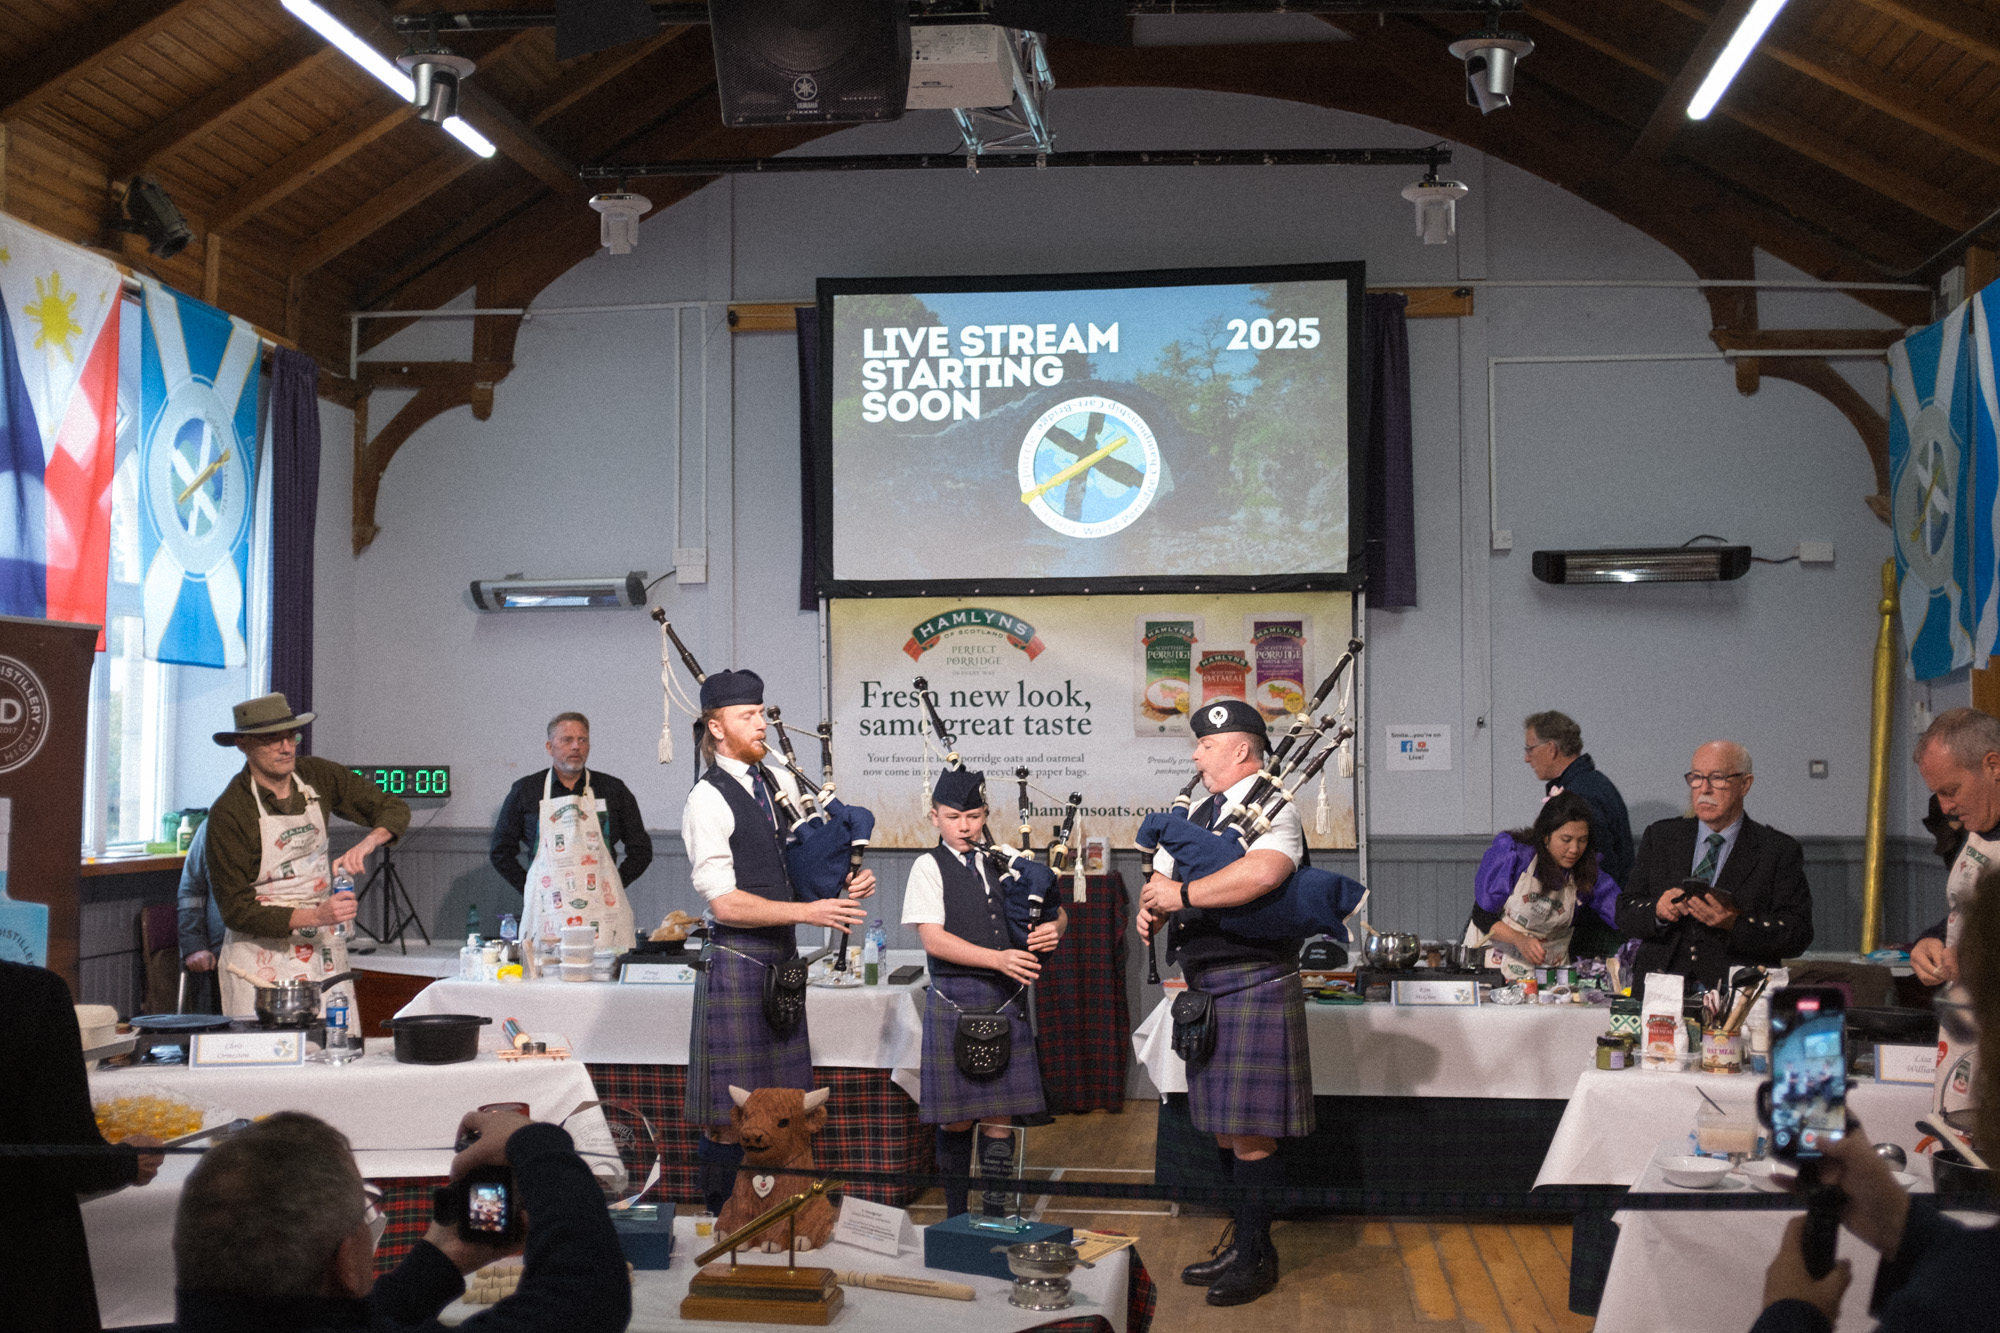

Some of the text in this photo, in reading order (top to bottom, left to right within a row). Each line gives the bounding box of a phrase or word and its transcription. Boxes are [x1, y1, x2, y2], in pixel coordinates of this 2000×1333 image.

[863, 322, 1120, 359] LIVE STREAM
[1226, 317, 1321, 351] 2025
[862, 355, 1064, 390] STARTING
[862, 390, 981, 423] SOON
[1037, 400, 1105, 431] Carr-Bridge
[1108, 402, 1158, 476] Championship
[1082, 521, 1120, 535] World
[920, 611, 1029, 638] HAMLYNS
[944, 629, 1004, 639] OF SCOTLAND
[1147, 626, 1193, 638] HAMLYNS
[1256, 626, 1301, 638] HAMLYNS
[952, 645, 997, 654] PERFECT
[946, 656, 1001, 665] PORRIDGE
[1201, 655, 1247, 667] HAMLYNS
[0, 664, 41, 724] ISTILLERY
[950, 690, 1010, 708] new
[1017, 679, 1091, 713] look,
[860, 715, 1092, 745] same great taste
[4, 733, 35, 762] HIGH
[867, 753, 890, 763] Your
[892, 752, 934, 763] favourie
[961, 753, 1001, 765] porridge
[1004, 755, 1023, 763] oats
[1026, 753, 1044, 763] and
[1046, 753, 1085, 763] oatmeal
[1147, 757, 1195, 766] Proudly gro
[912, 767, 921, 776] in
[987, 767, 1034, 778] recycle
[1036, 769, 1062, 779] paper
[1065, 767, 1089, 778] bags.
[1155, 768, 1190, 776] packaged
[1029, 801, 1175, 817] hamnsoats.cou
[0, 928, 34, 966] ISTILLE
[1914, 1055, 1932, 1063] Lisa
